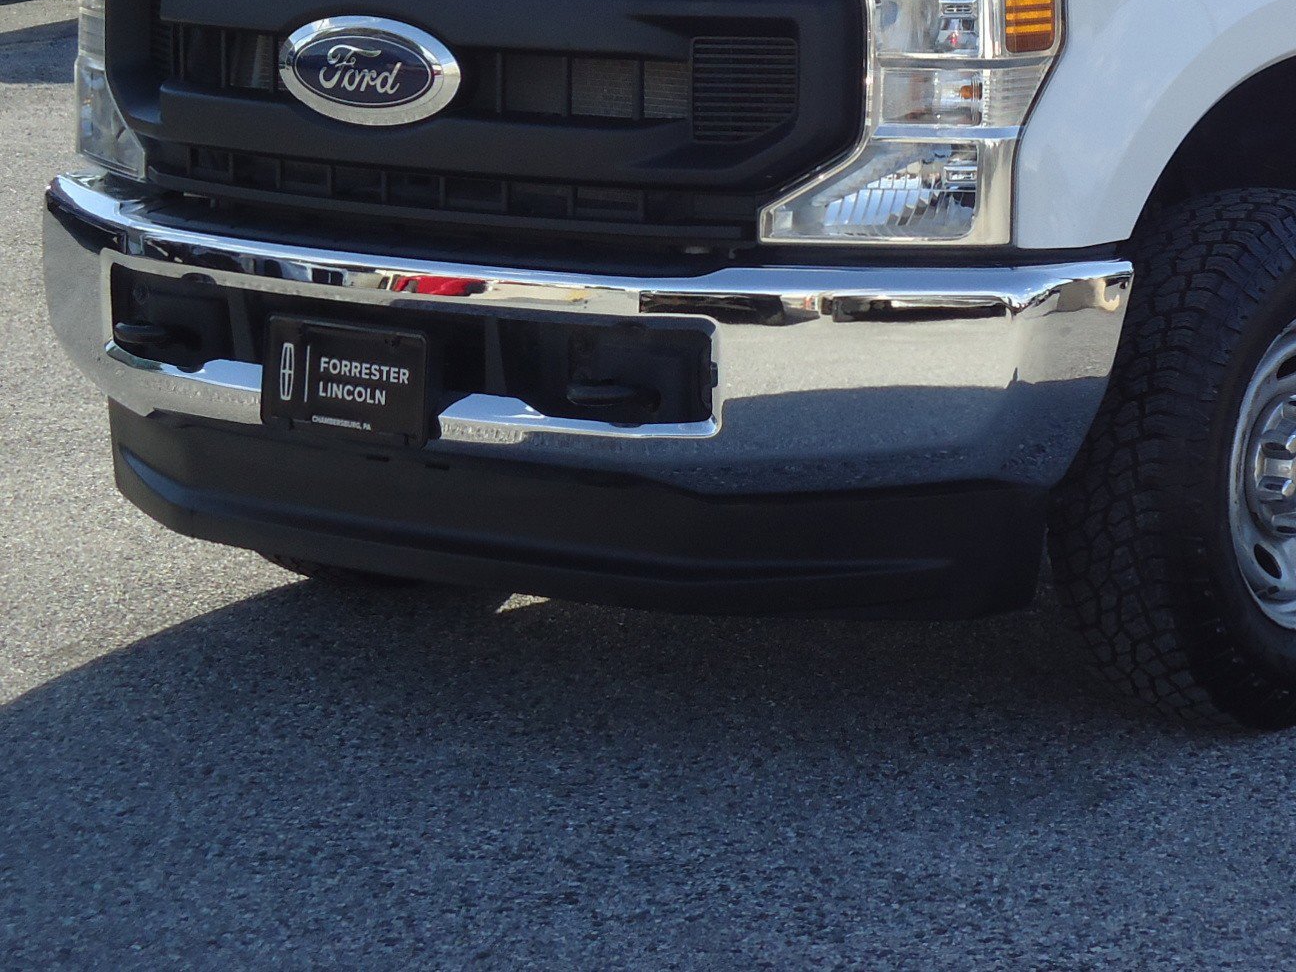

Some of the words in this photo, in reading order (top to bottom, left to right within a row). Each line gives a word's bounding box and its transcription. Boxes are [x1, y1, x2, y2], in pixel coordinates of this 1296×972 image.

[319, 44, 402, 94] Ford
[320, 356, 409, 385] FORRESTER
[318, 381, 386, 406] LINCOLN
[362, 422, 372, 431] PA
